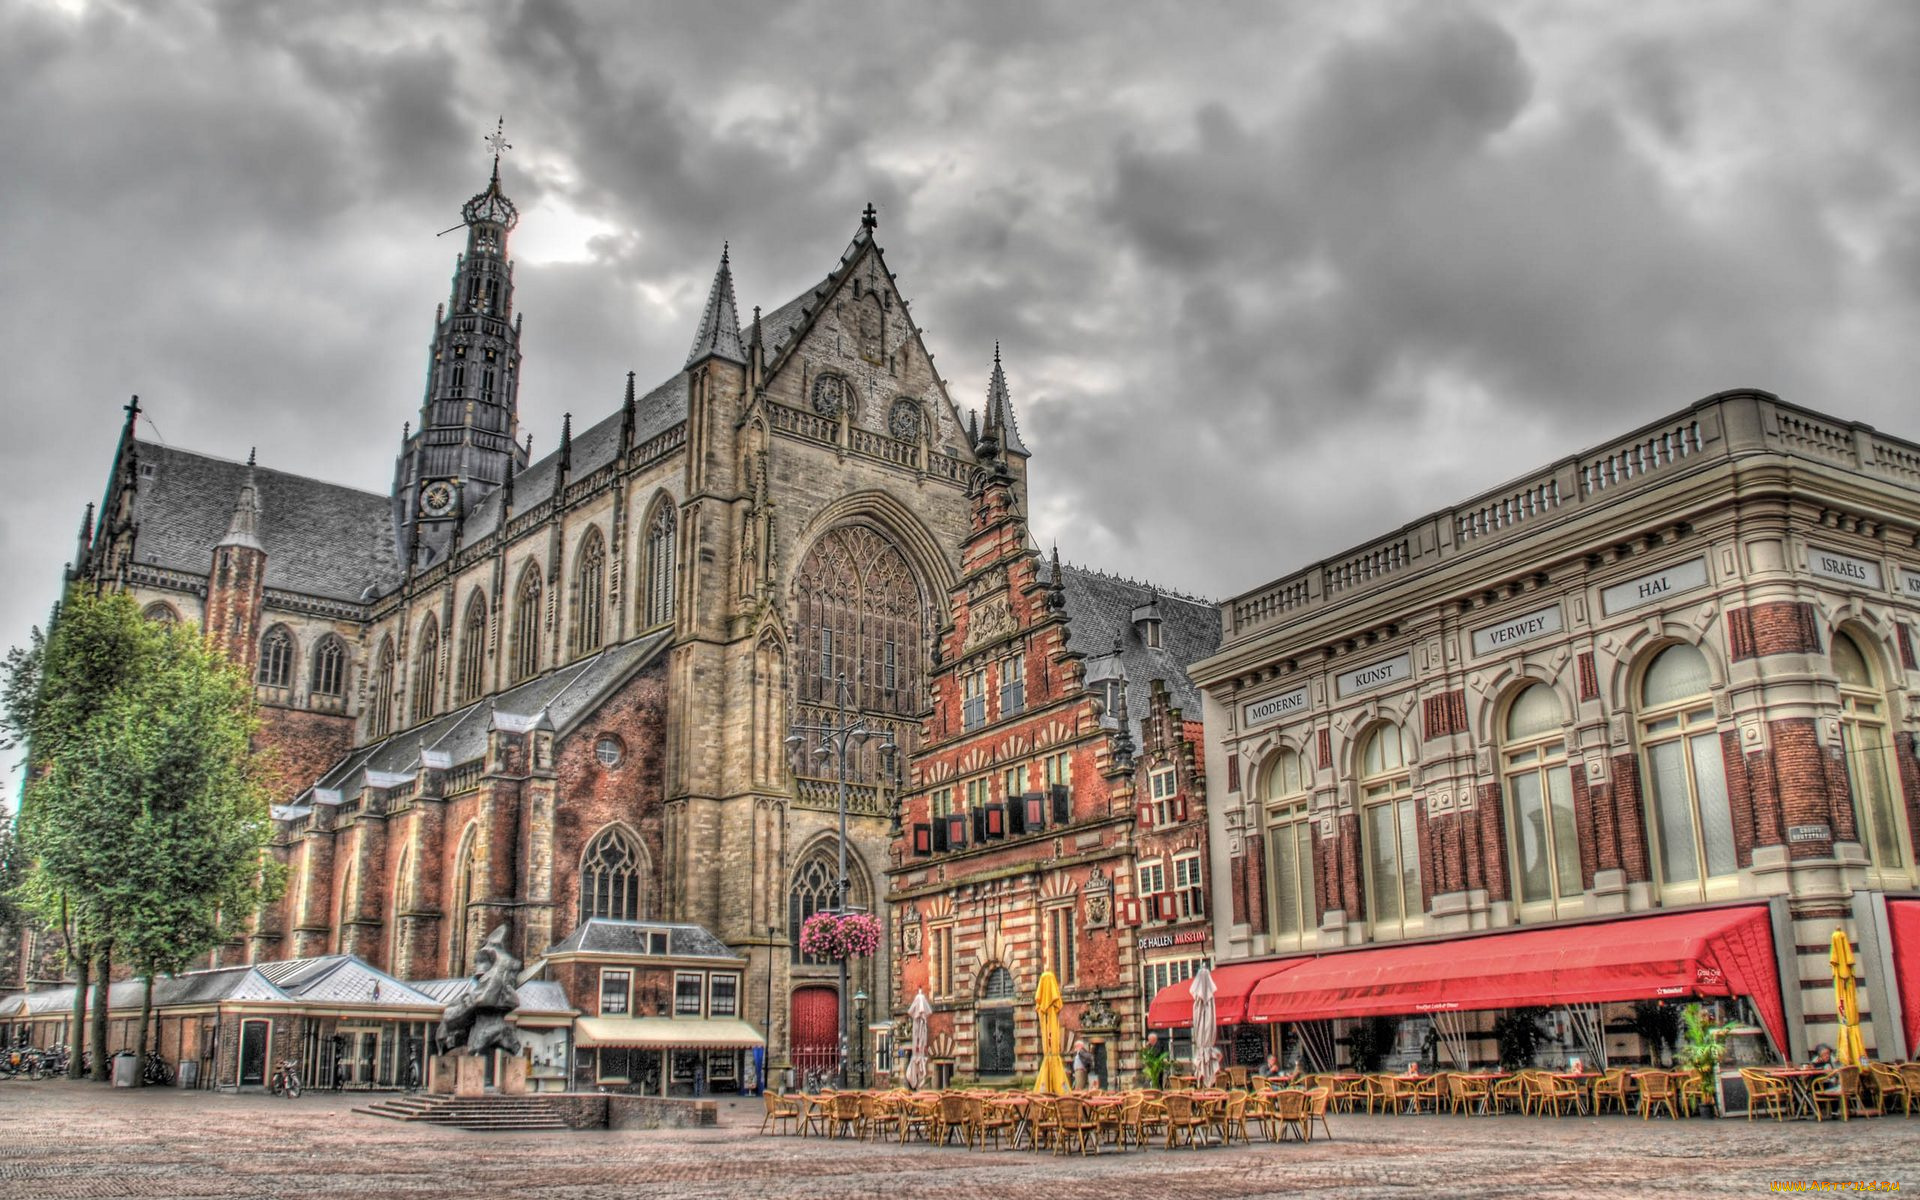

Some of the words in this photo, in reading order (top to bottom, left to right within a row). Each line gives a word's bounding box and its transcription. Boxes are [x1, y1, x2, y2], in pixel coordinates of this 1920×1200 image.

[1821, 557, 1866, 580] ISRAËLS
[1637, 576, 1671, 599] HAL
[1489, 616, 1545, 645] VERWEY
[1355, 664, 1393, 687] KUNST
[1252, 693, 1303, 720] MODERNE
[1138, 938, 1148, 950] DE
[1148, 935, 1173, 949] HALLEN
[1174, 929, 1206, 945] MUSEUM
